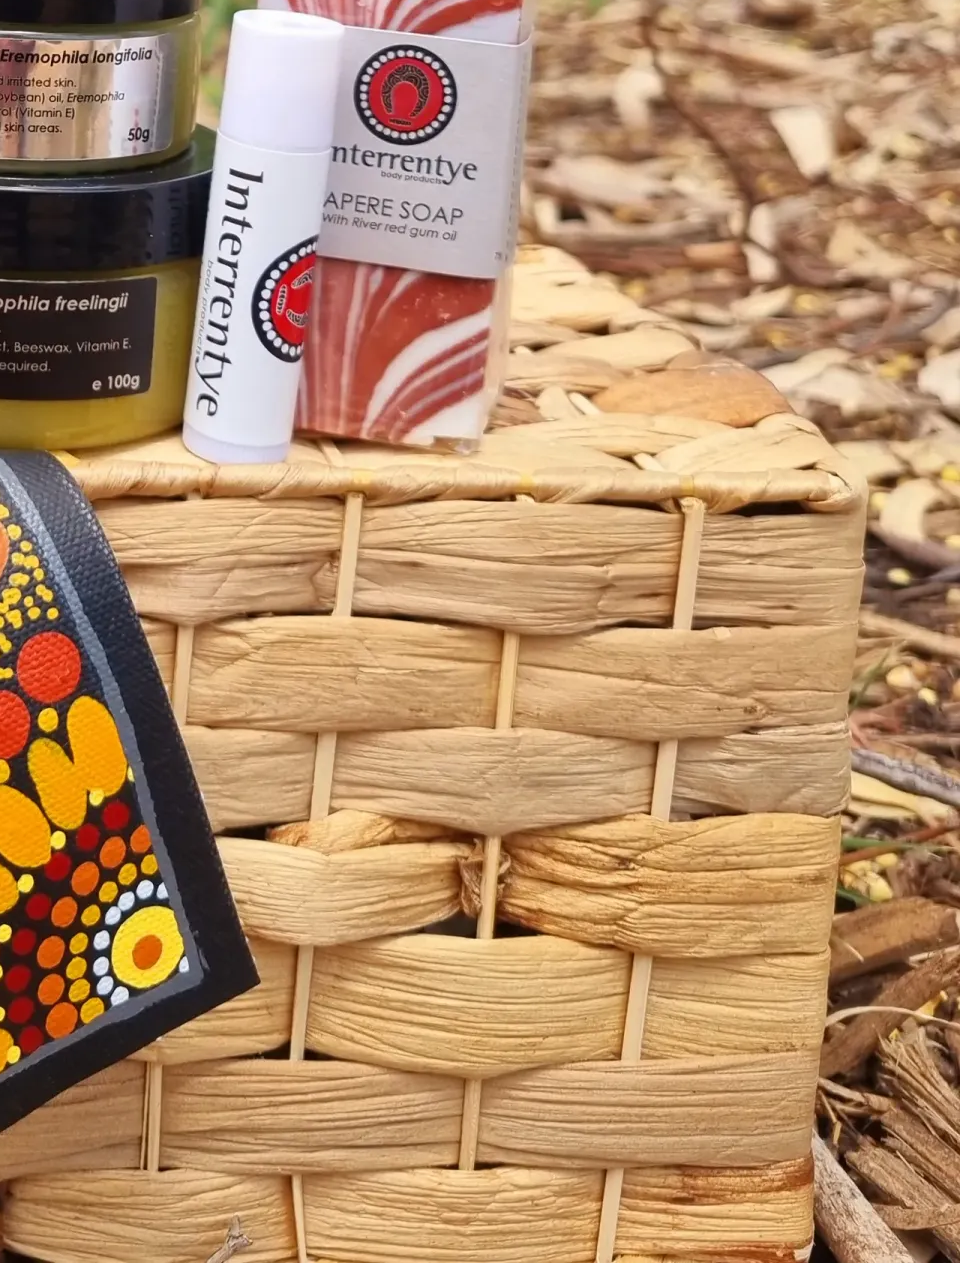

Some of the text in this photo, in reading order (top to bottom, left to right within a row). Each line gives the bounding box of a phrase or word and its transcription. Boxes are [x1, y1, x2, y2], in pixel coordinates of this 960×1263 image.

[0, 48, 89, 67] Eremophila
[92, 47, 153, 66] longifolia
[7, 76, 52, 89] irritated
[54, 77, 77, 89] skin.
[49, 91, 64, 104] oil,
[67, 90, 125, 104] Eremophila
[15, 106, 62, 119] (Vitamin
[65, 107, 75, 120] E)
[4, 121, 25, 133] skin
[27, 123, 62, 134] areas.
[127, 126, 150, 142] 50g
[330, 143, 478, 186] nterrentye
[380, 169, 444, 186] body products
[323, 191, 464, 226] APERE SOAP
[322, 212, 458, 242] With River red gum oil
[195, 167, 265, 418] Interrentye
[54, 292, 129, 313] freelingii
[196, 259, 214, 358] body products
[76, 338, 120, 353] Vitamin
[123, 337, 132, 350] E.
[107, 373, 141, 390] 100g
